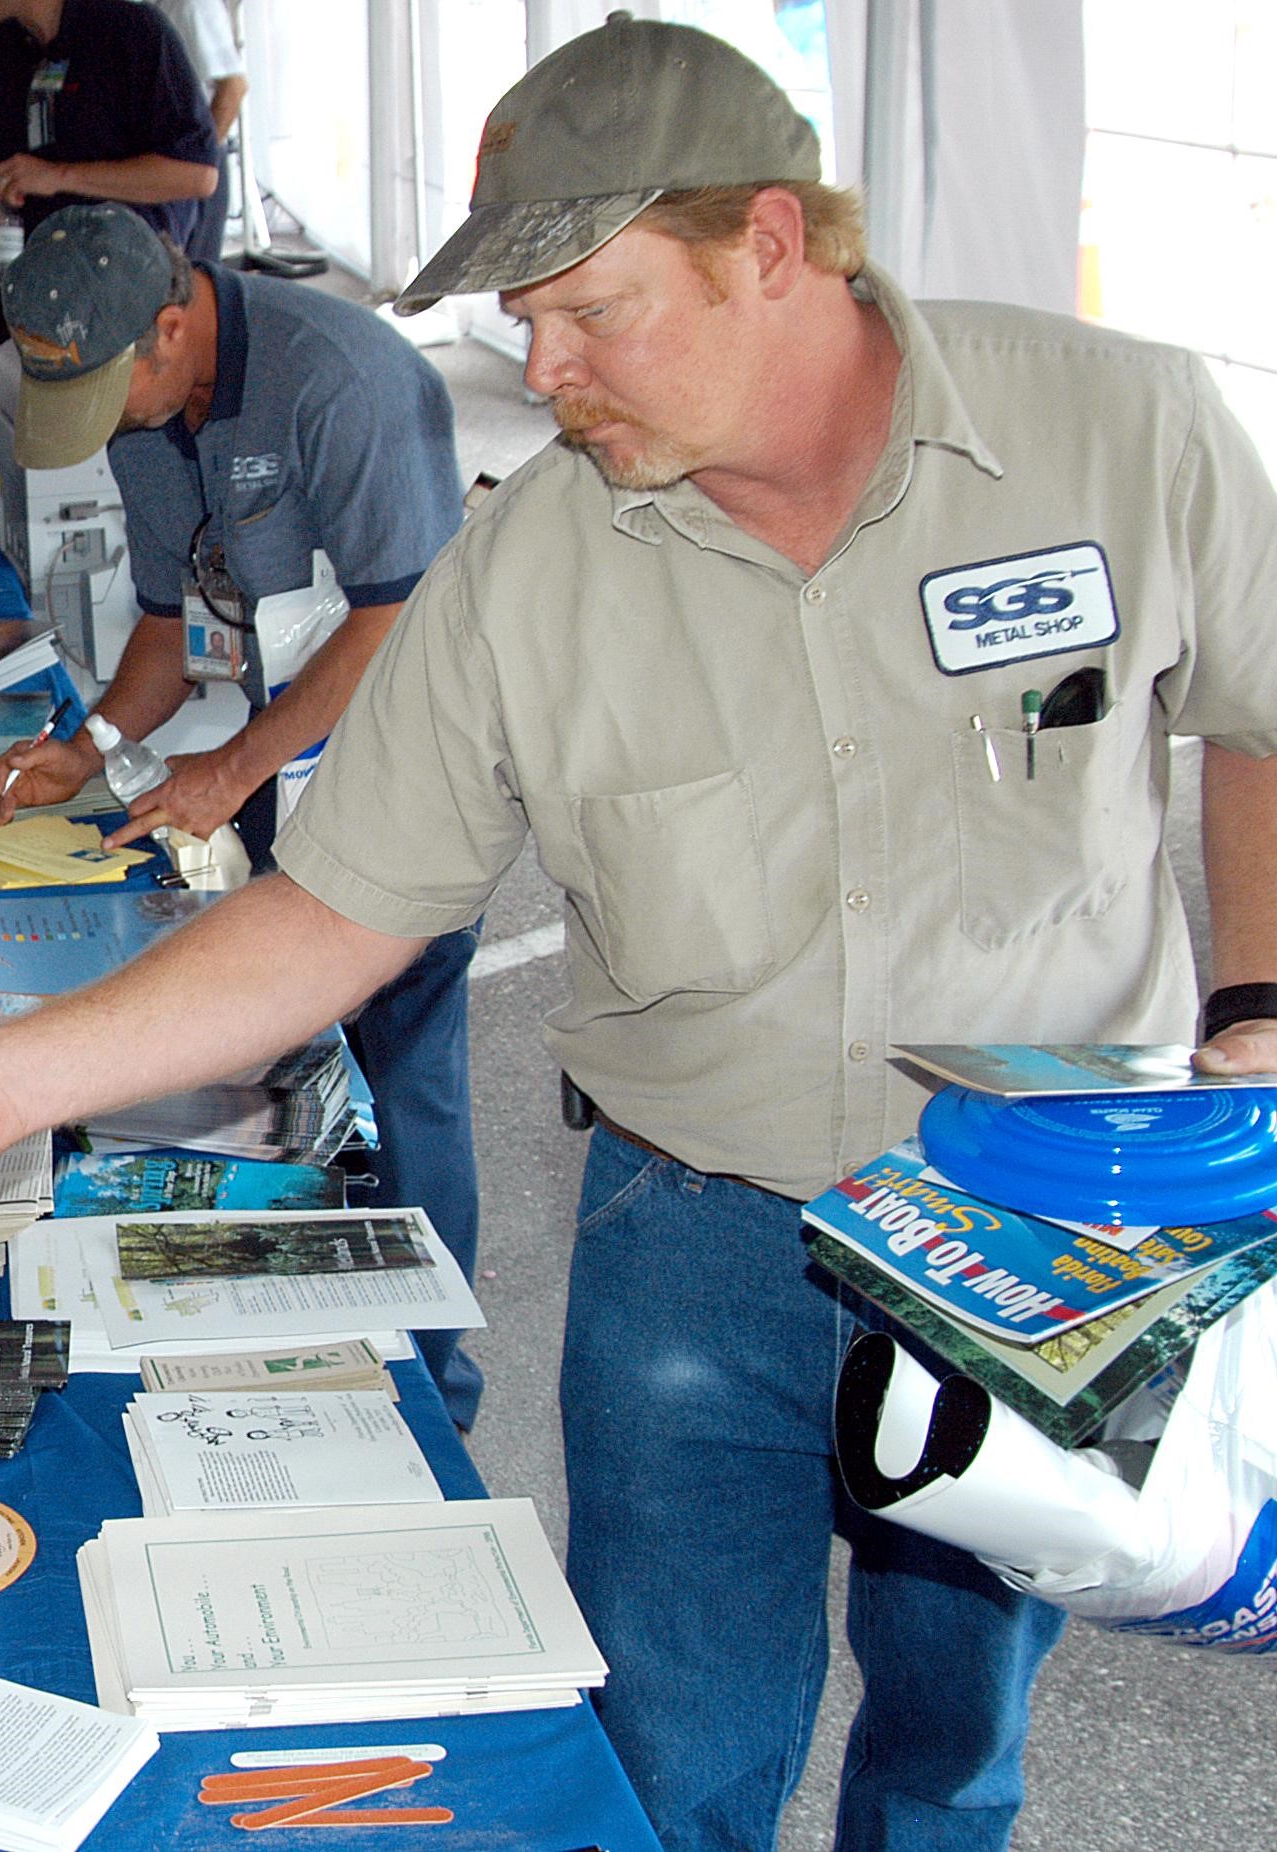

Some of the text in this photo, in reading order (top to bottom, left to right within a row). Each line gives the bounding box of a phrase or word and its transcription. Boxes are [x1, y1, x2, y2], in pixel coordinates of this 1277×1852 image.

[944, 570, 1098, 630] SGS
[975, 614, 1084, 648] METAL SHOP
[139, 1159, 176, 1211] Spring
[853, 1167, 1002, 1233] Smart!
[848, 1187, 1063, 1322] HOW TO BOAT
[1052, 1254, 1122, 1294] Florida
[250, 1584, 286, 1667] Your Environment
